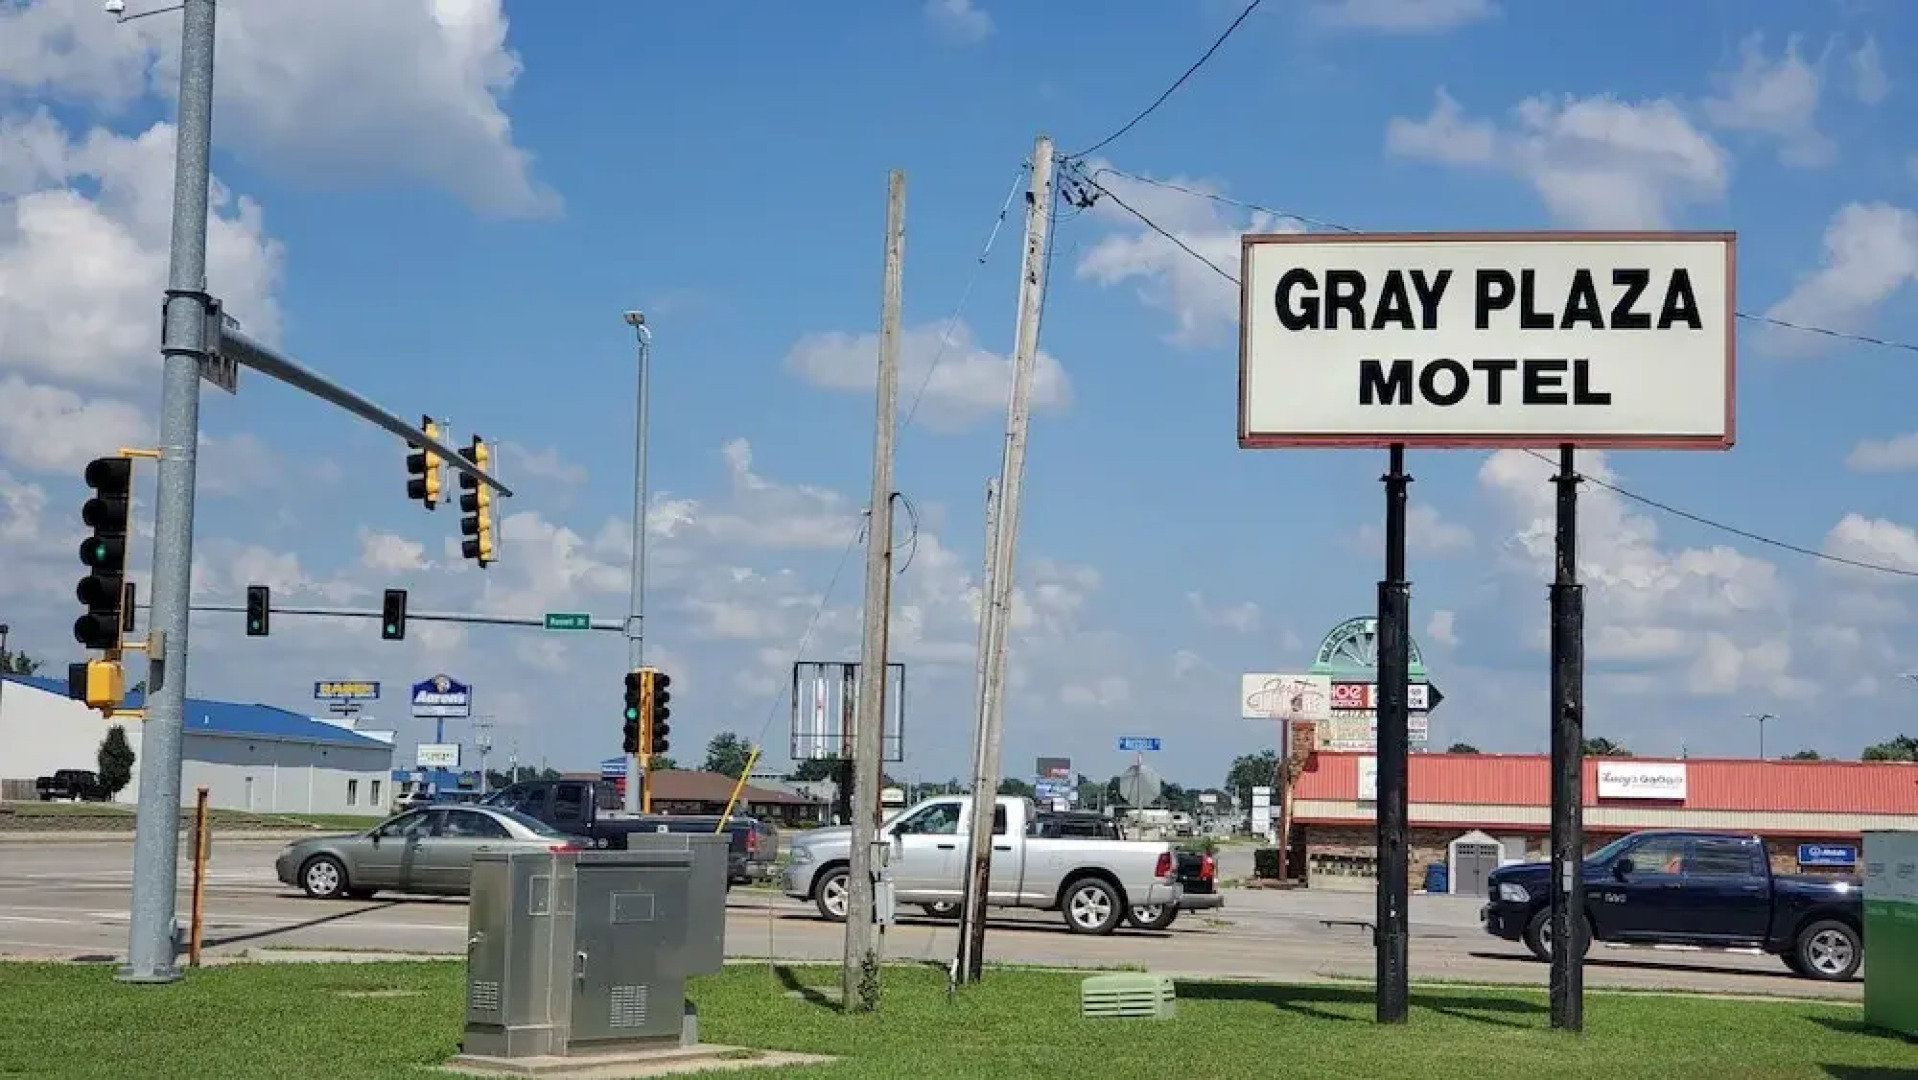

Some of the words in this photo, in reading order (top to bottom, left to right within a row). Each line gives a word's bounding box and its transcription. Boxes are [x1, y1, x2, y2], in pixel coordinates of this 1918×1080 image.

[1275, 268, 1453, 331] GRAY
[1475, 268, 1703, 331] PLAZA
[1359, 358, 1612, 406] MOTEL
[415, 690, 466, 704] Aaron's
